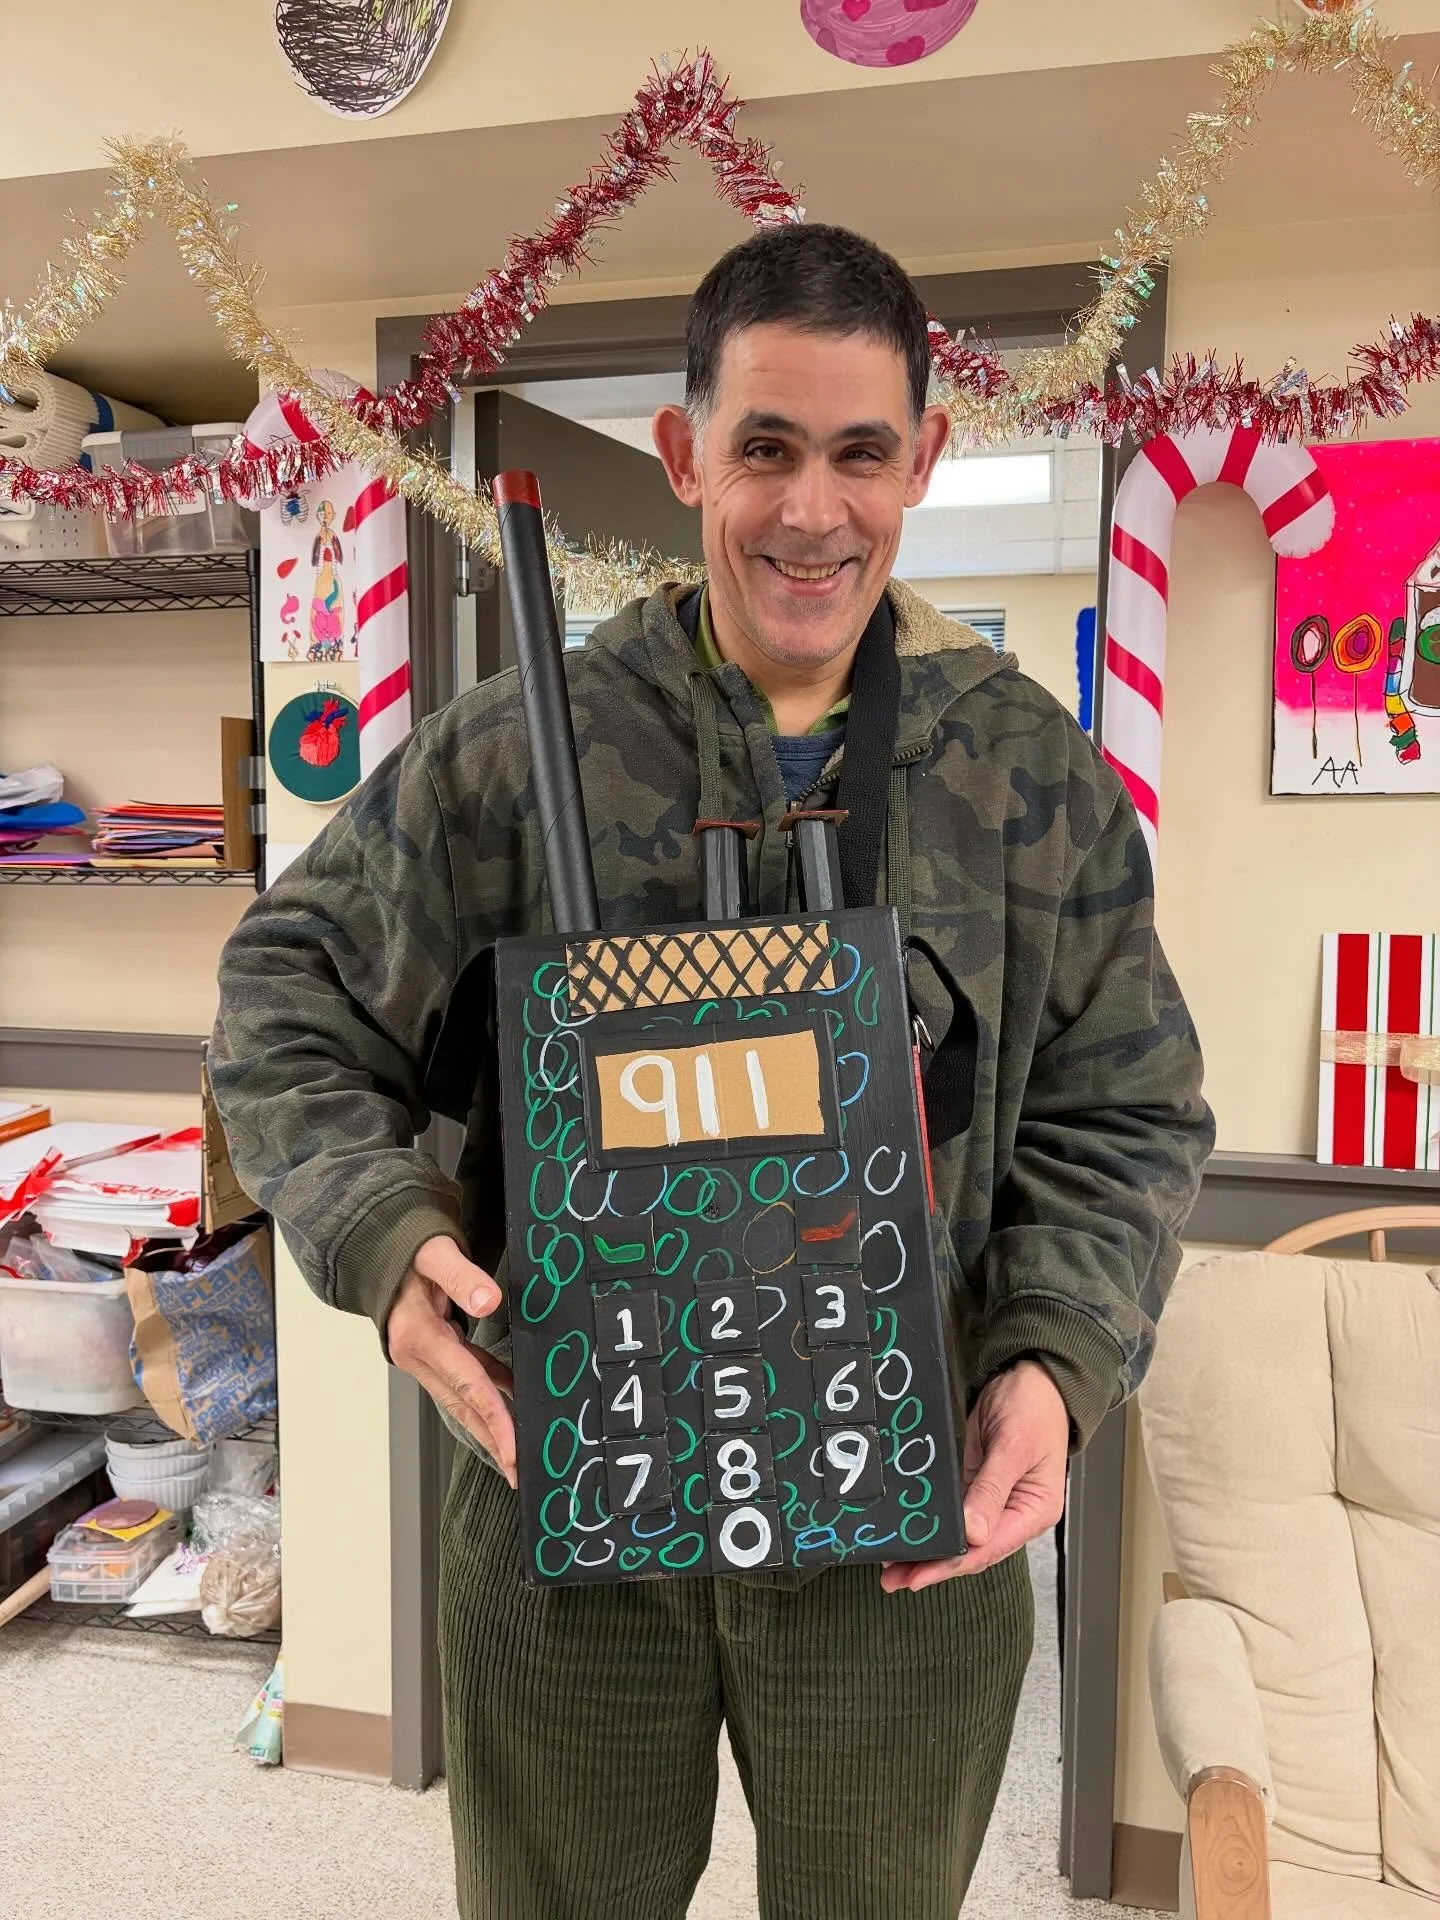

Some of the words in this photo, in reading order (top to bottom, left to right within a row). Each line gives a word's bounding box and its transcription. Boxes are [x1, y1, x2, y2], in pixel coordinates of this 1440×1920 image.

[619, 1049, 770, 1147] 911
[615, 1308, 643, 1352] 1
[710, 1296, 743, 1340] 2
[814, 1284, 846, 1330] 3
[611, 1374, 643, 1429] 4
[713, 1365, 752, 1419] 5
[825, 1360, 860, 1412] 6
[615, 1453, 653, 1509] 7
[716, 1438, 761, 1500] 8
[825, 1430, 870, 1495] 9
[719, 1506, 772, 1568] 0
